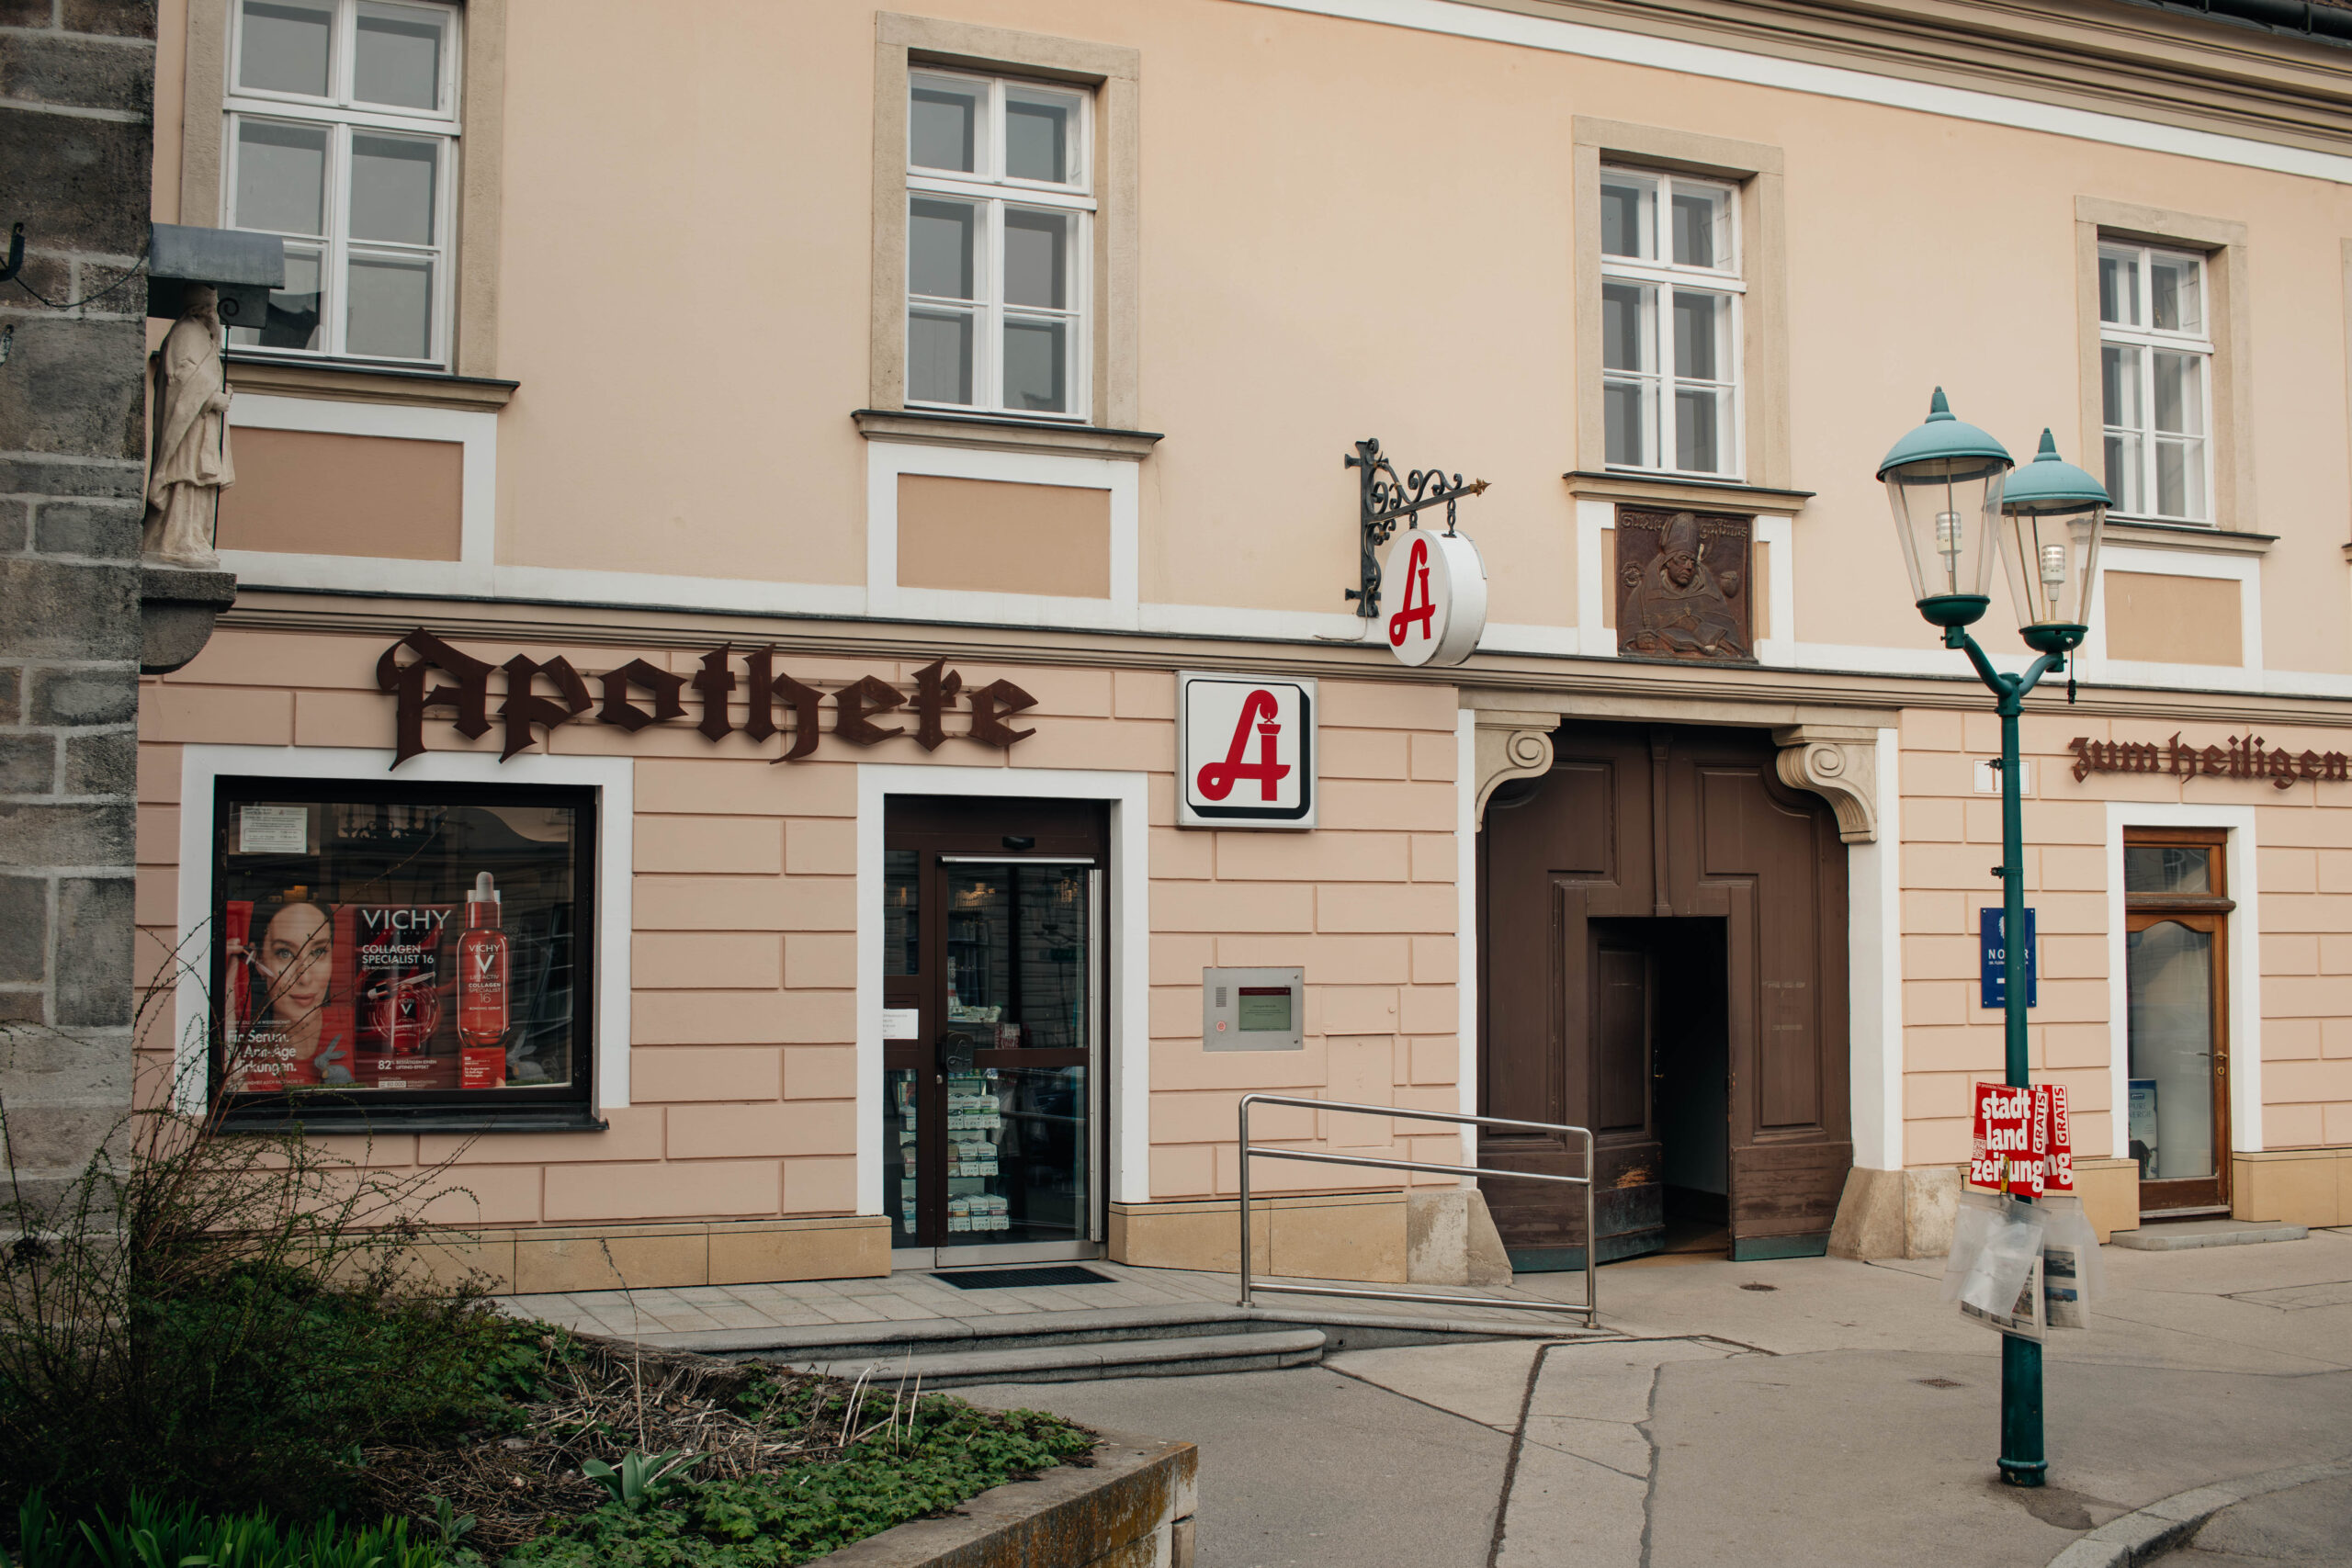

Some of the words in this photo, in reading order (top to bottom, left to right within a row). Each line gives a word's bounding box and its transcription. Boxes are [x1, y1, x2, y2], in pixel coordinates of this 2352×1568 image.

[377, 627, 1039, 772] Apotheke
[362, 909, 451, 930] VICHY
[362, 944, 421, 953] COLLAGEN
[362, 954, 419, 964] SPECIALIST
[423, 954, 435, 964] 16
[469, 944, 501, 953] VICHY
[1988, 949, 2029, 960] NOR
[480, 992, 492, 1004] 16
[1982, 1088, 2031, 1120] stadt
[2035, 1094, 2046, 1151] GRATIS
[2055, 1087, 2067, 1145] GRATIS
[1986, 1119, 2028, 1150] land
